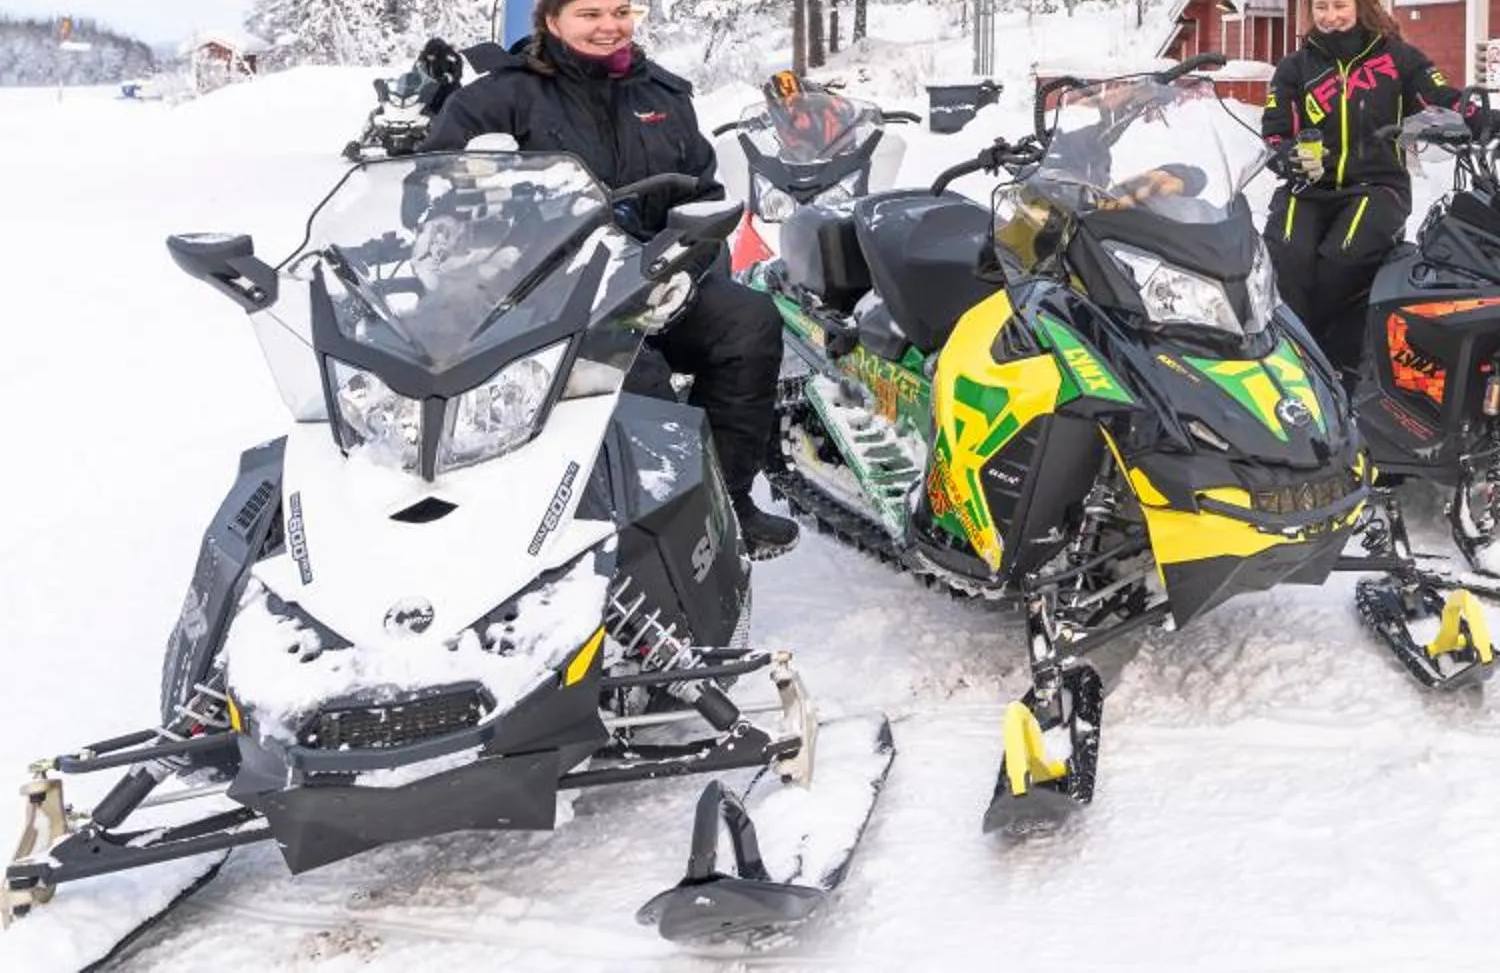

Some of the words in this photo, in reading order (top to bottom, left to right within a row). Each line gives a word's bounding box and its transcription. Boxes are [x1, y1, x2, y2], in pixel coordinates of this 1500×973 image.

[1313, 53, 1399, 114] FXR
[1063, 348, 1114, 391] LYNX
[544, 484, 573, 532] 600
[288, 516, 308, 562] 600
